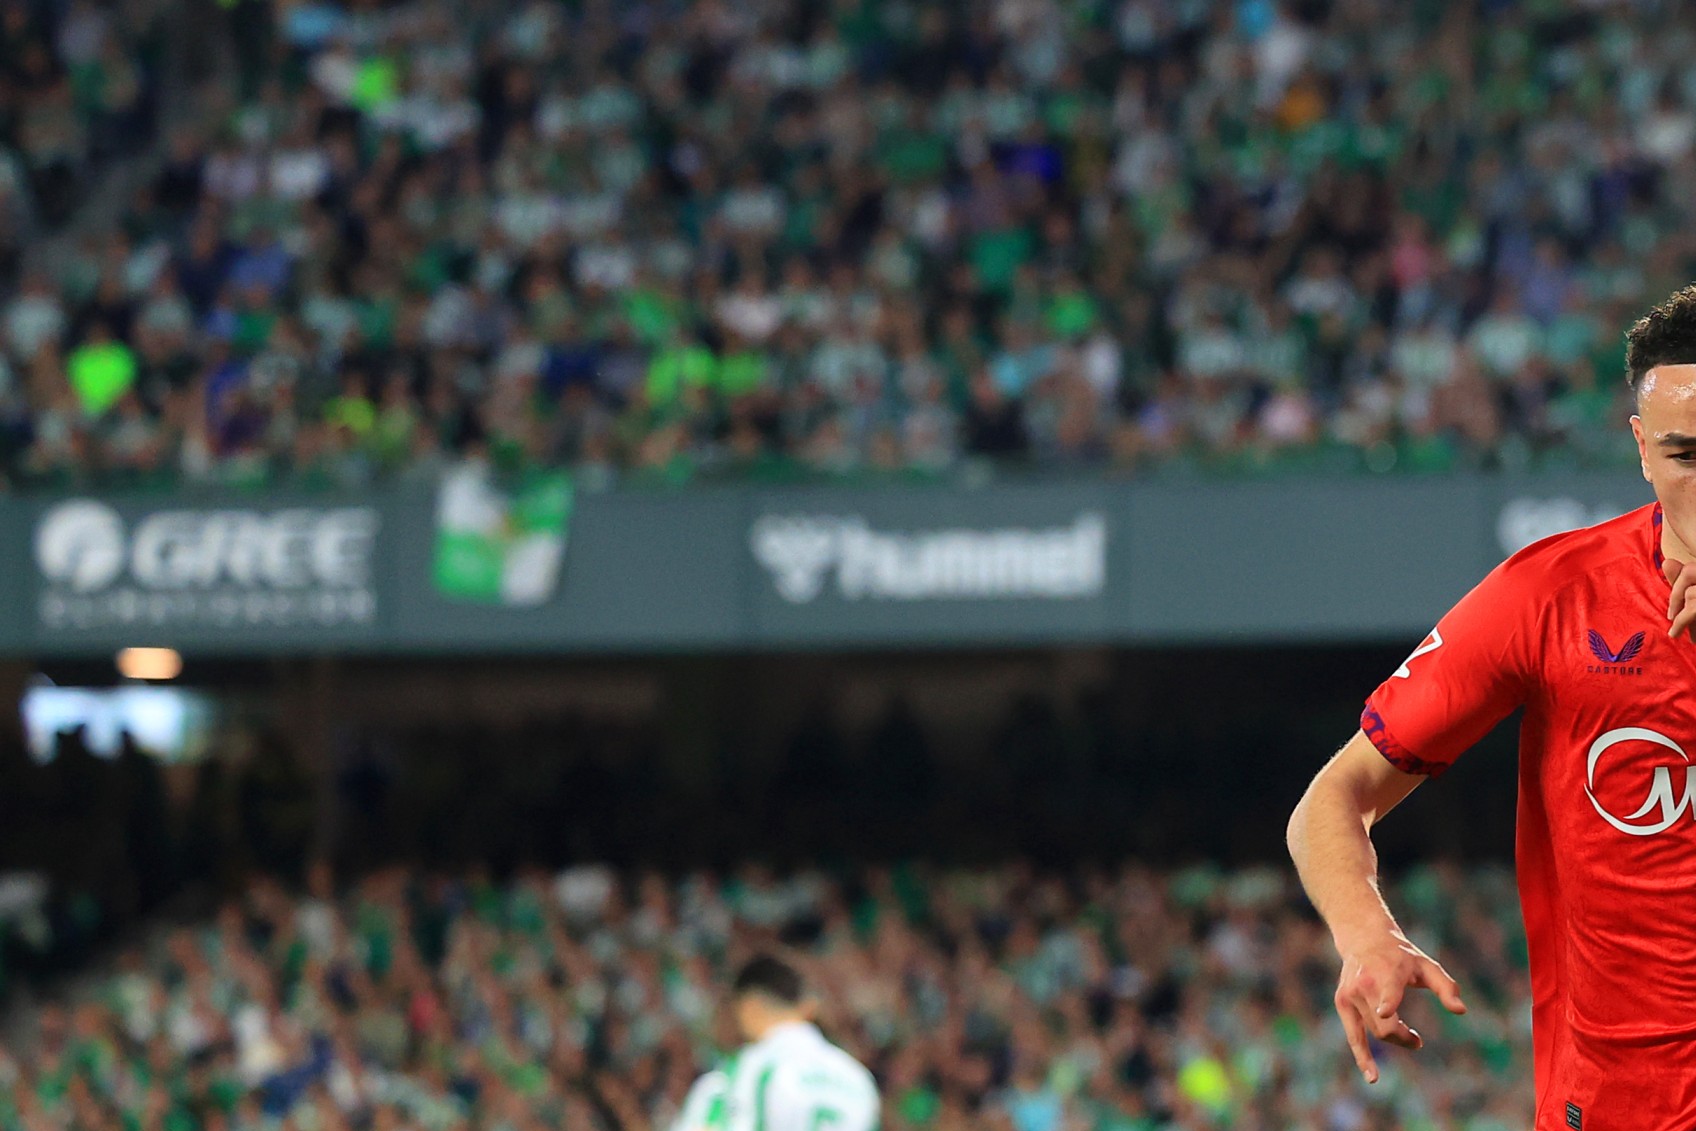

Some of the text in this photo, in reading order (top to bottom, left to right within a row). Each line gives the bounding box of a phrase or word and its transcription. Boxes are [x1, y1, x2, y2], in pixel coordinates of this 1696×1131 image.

[131, 506, 382, 588] GREE
[837, 511, 1106, 600] hummel
[1587, 664, 1643, 677] CASTORE
